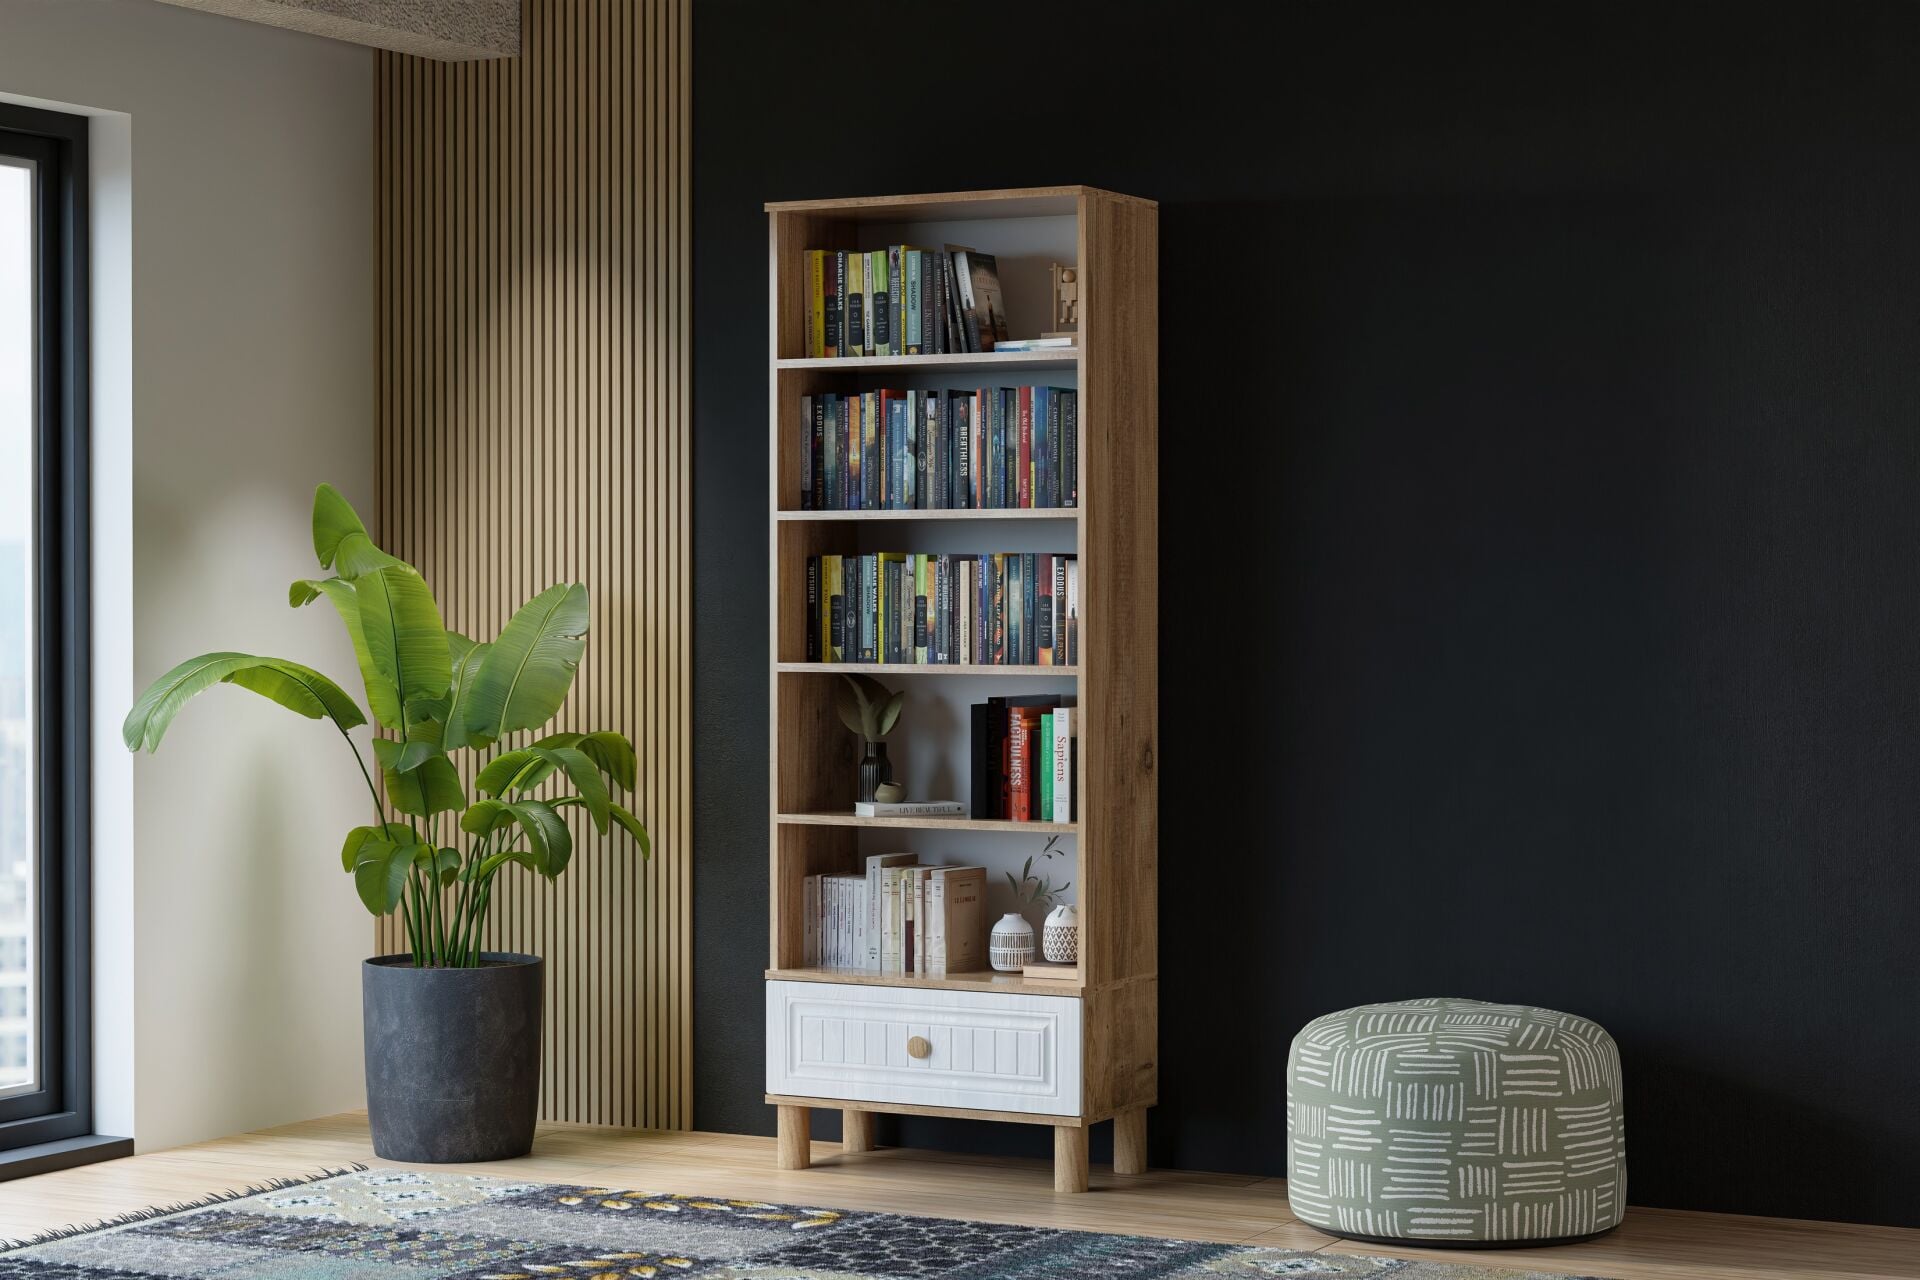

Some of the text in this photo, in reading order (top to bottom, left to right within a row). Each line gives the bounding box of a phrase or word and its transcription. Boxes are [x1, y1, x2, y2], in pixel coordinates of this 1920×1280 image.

[924, 308, 933, 354] ENCHANTRESS
[960, 426, 968, 477] BREATHLESS
[1057, 567, 1065, 596] EXODUS
[1010, 714, 1021, 785] FACTFULNESS
[1055, 736, 1068, 782] Sapiens
